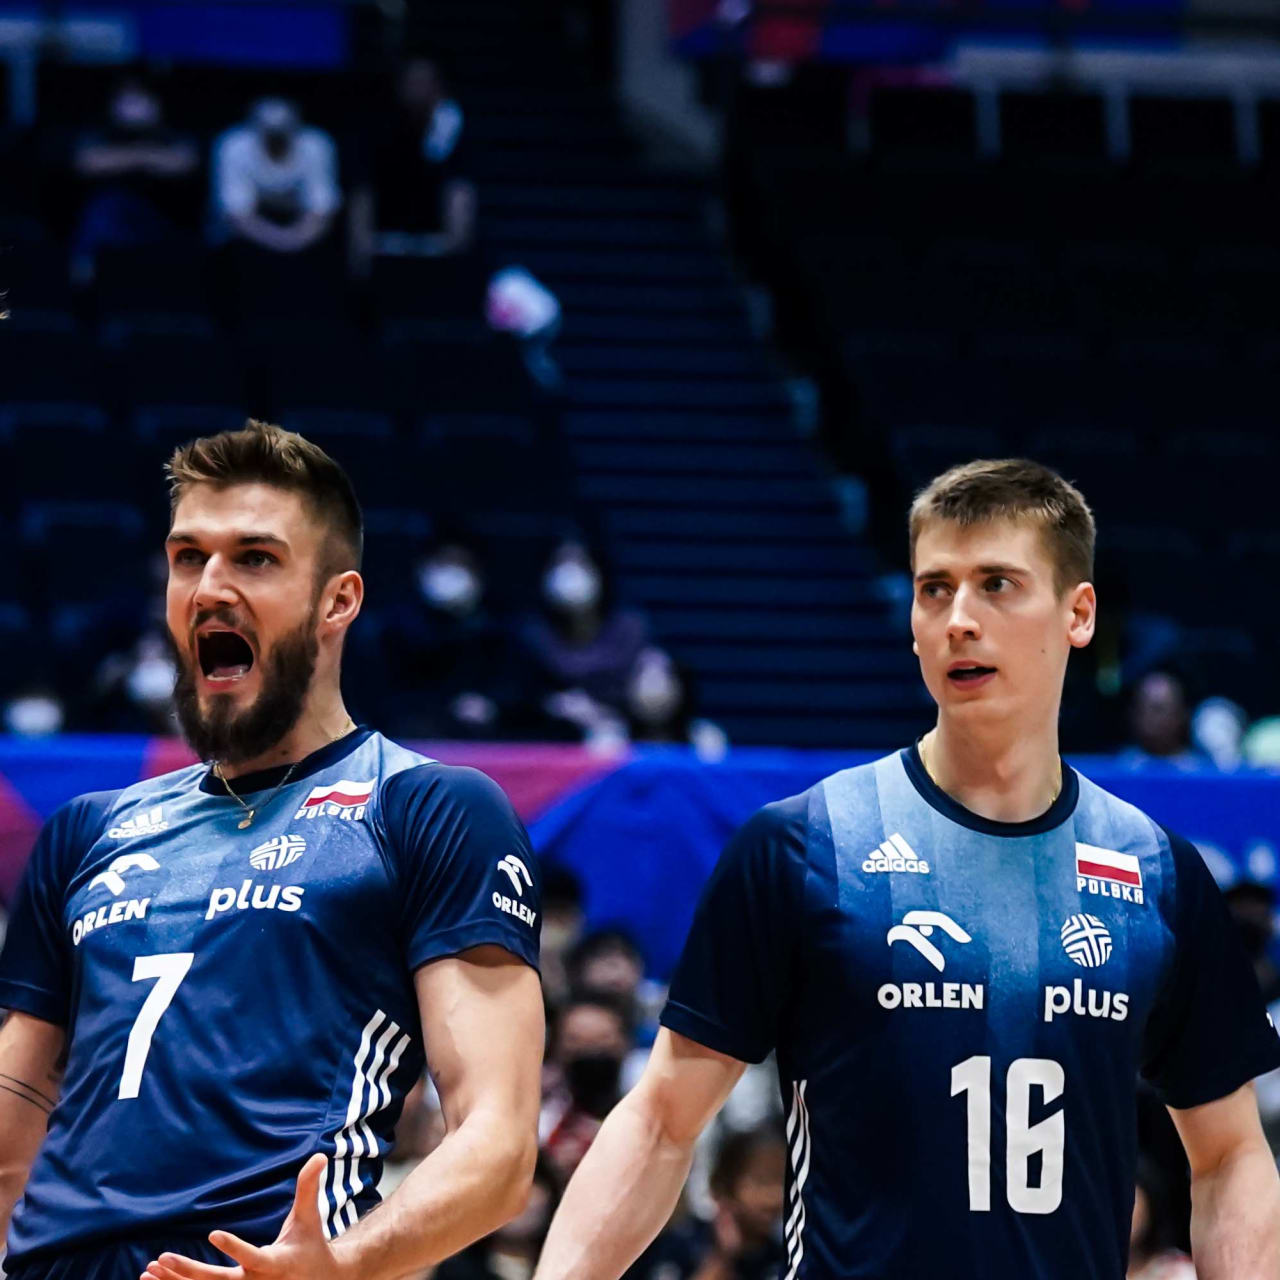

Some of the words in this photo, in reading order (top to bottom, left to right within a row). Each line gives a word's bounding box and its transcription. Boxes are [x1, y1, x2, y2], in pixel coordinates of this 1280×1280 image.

[294, 804, 366, 821] POLSKA
[862, 857, 930, 874] adidas
[204, 880, 305, 920] plus
[1076, 876, 1144, 904] POLSKA
[73, 898, 151, 946] ORLEN
[492, 891, 537, 928] ORLEN
[877, 982, 984, 1010] ORLEN
[1044, 978, 1130, 1022] plus
[118, 952, 195, 1100] 7
[950, 1055, 1065, 1215] 16
